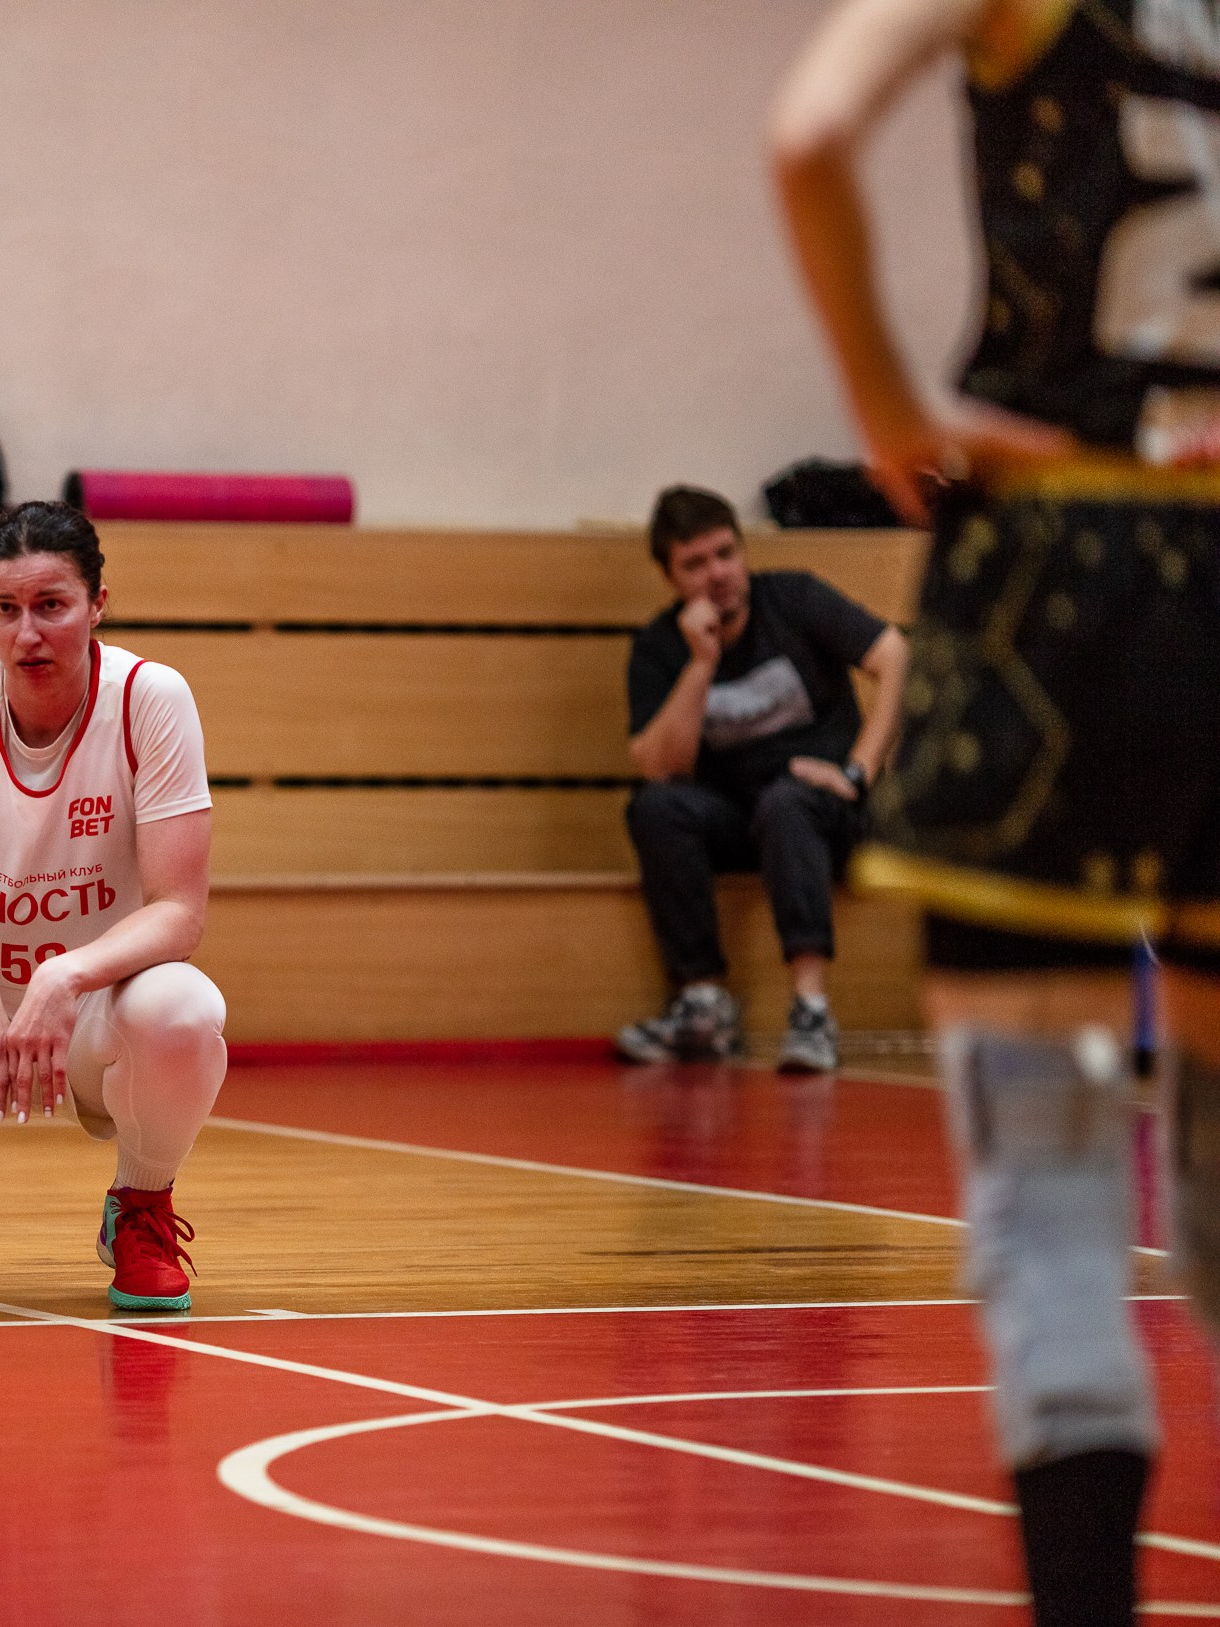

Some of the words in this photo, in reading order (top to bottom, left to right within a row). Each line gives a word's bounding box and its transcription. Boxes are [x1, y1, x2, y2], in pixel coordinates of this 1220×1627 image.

[68, 795, 112, 819] FON
[70, 814, 115, 839] BET
[70, 864, 103, 877] КЛУБ
